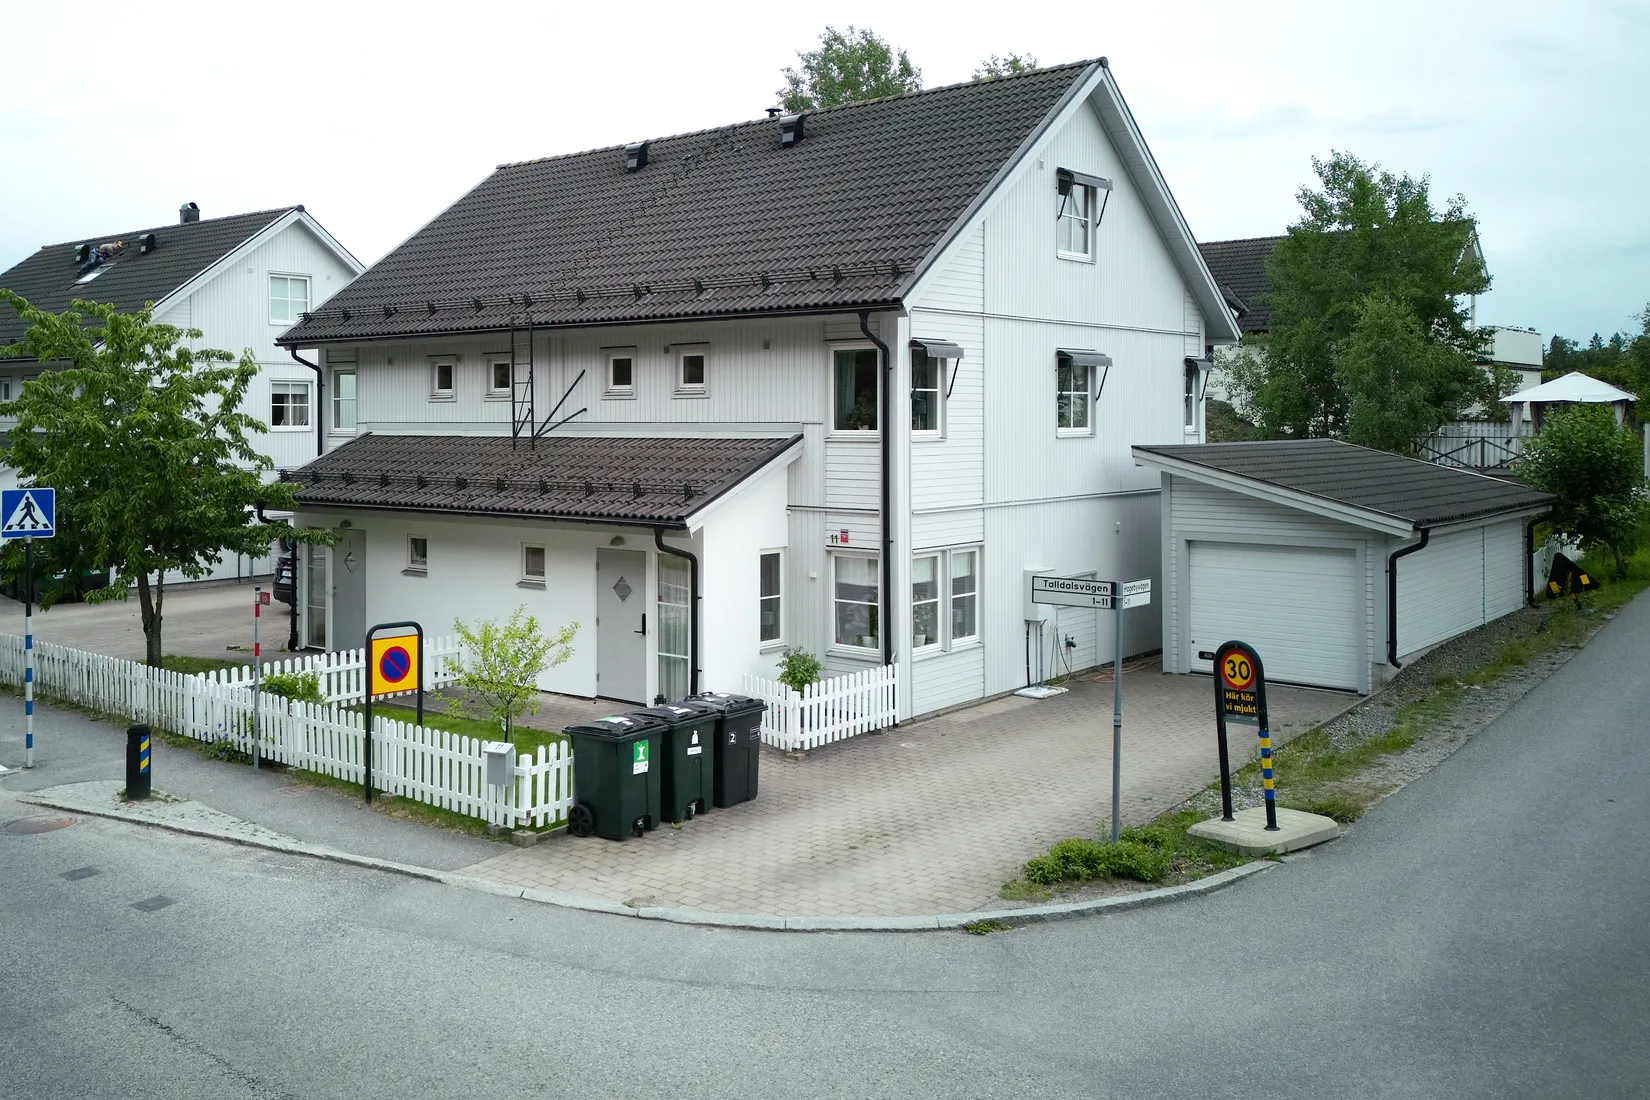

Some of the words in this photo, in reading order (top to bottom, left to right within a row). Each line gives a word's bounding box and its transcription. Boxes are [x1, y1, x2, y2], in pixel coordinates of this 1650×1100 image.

[830, 534, 838, 544] 11
[1043, 580, 1108, 593] Talldalsvägen
[1226, 659, 1251, 680] 30
[1225, 691, 1239, 700] Här
[1241, 692, 1254, 701] kör
[1225, 702, 1233, 710] vi
[1234, 705, 1257, 713] mjukt
[730, 733, 735, 743] 2
